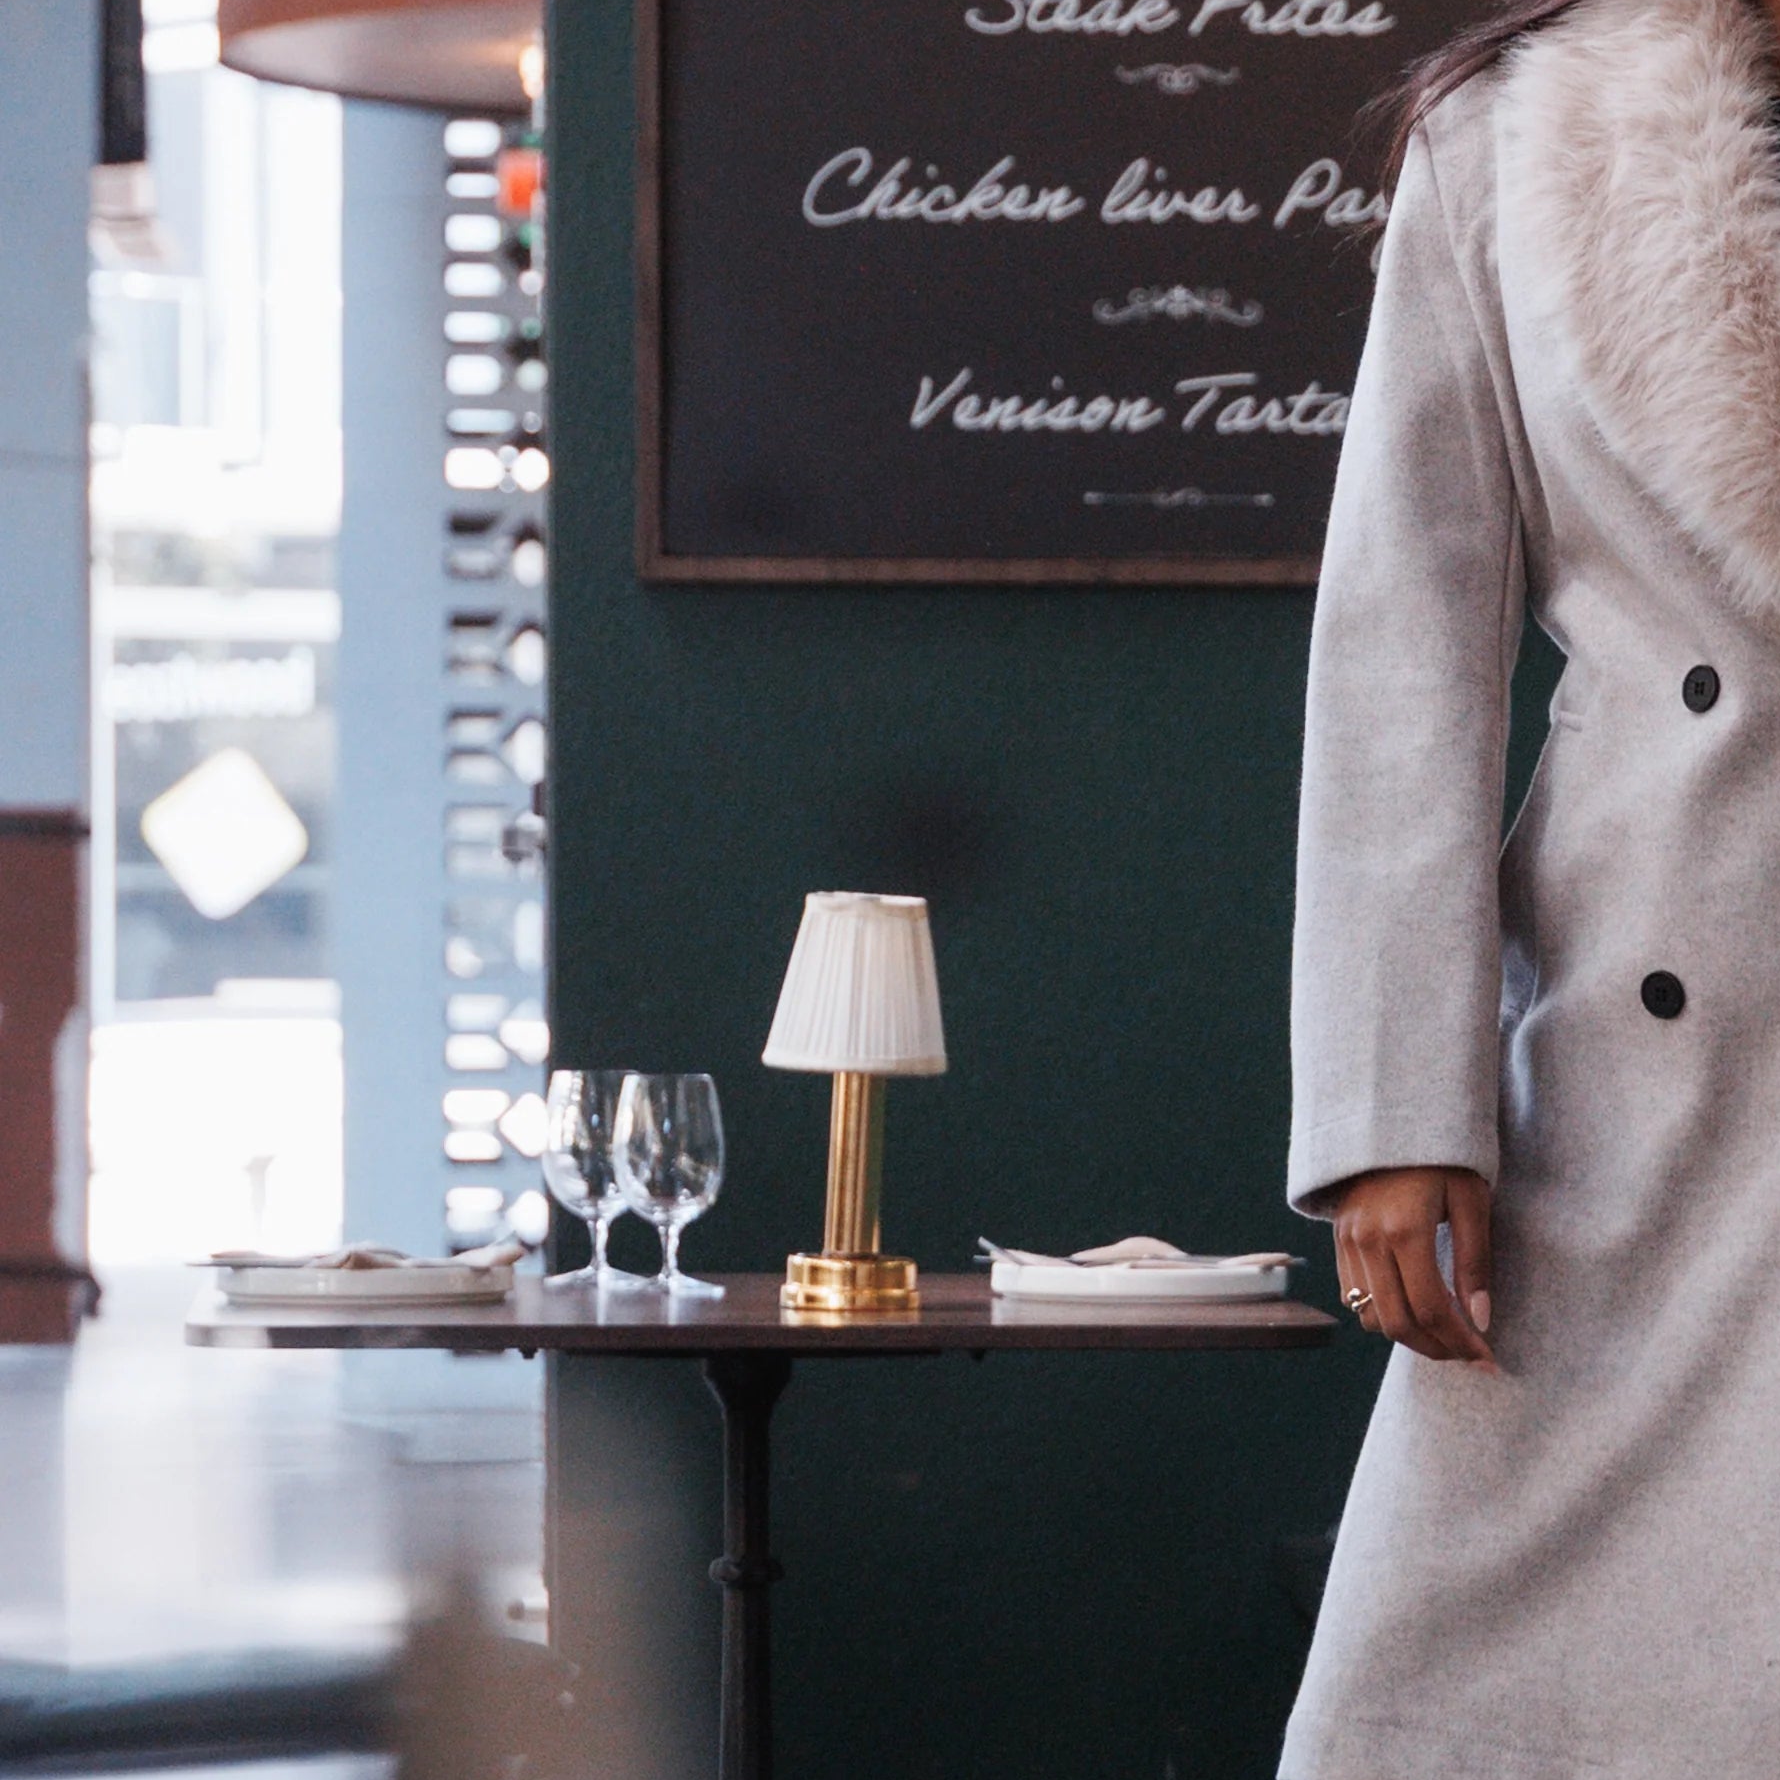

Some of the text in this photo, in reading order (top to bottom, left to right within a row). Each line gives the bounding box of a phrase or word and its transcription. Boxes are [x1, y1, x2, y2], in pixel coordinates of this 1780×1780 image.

[802, 147, 1083, 226] Chicken
[1100, 157, 1256, 224] liver
[909, 367, 1350, 435] Venison Tarta
